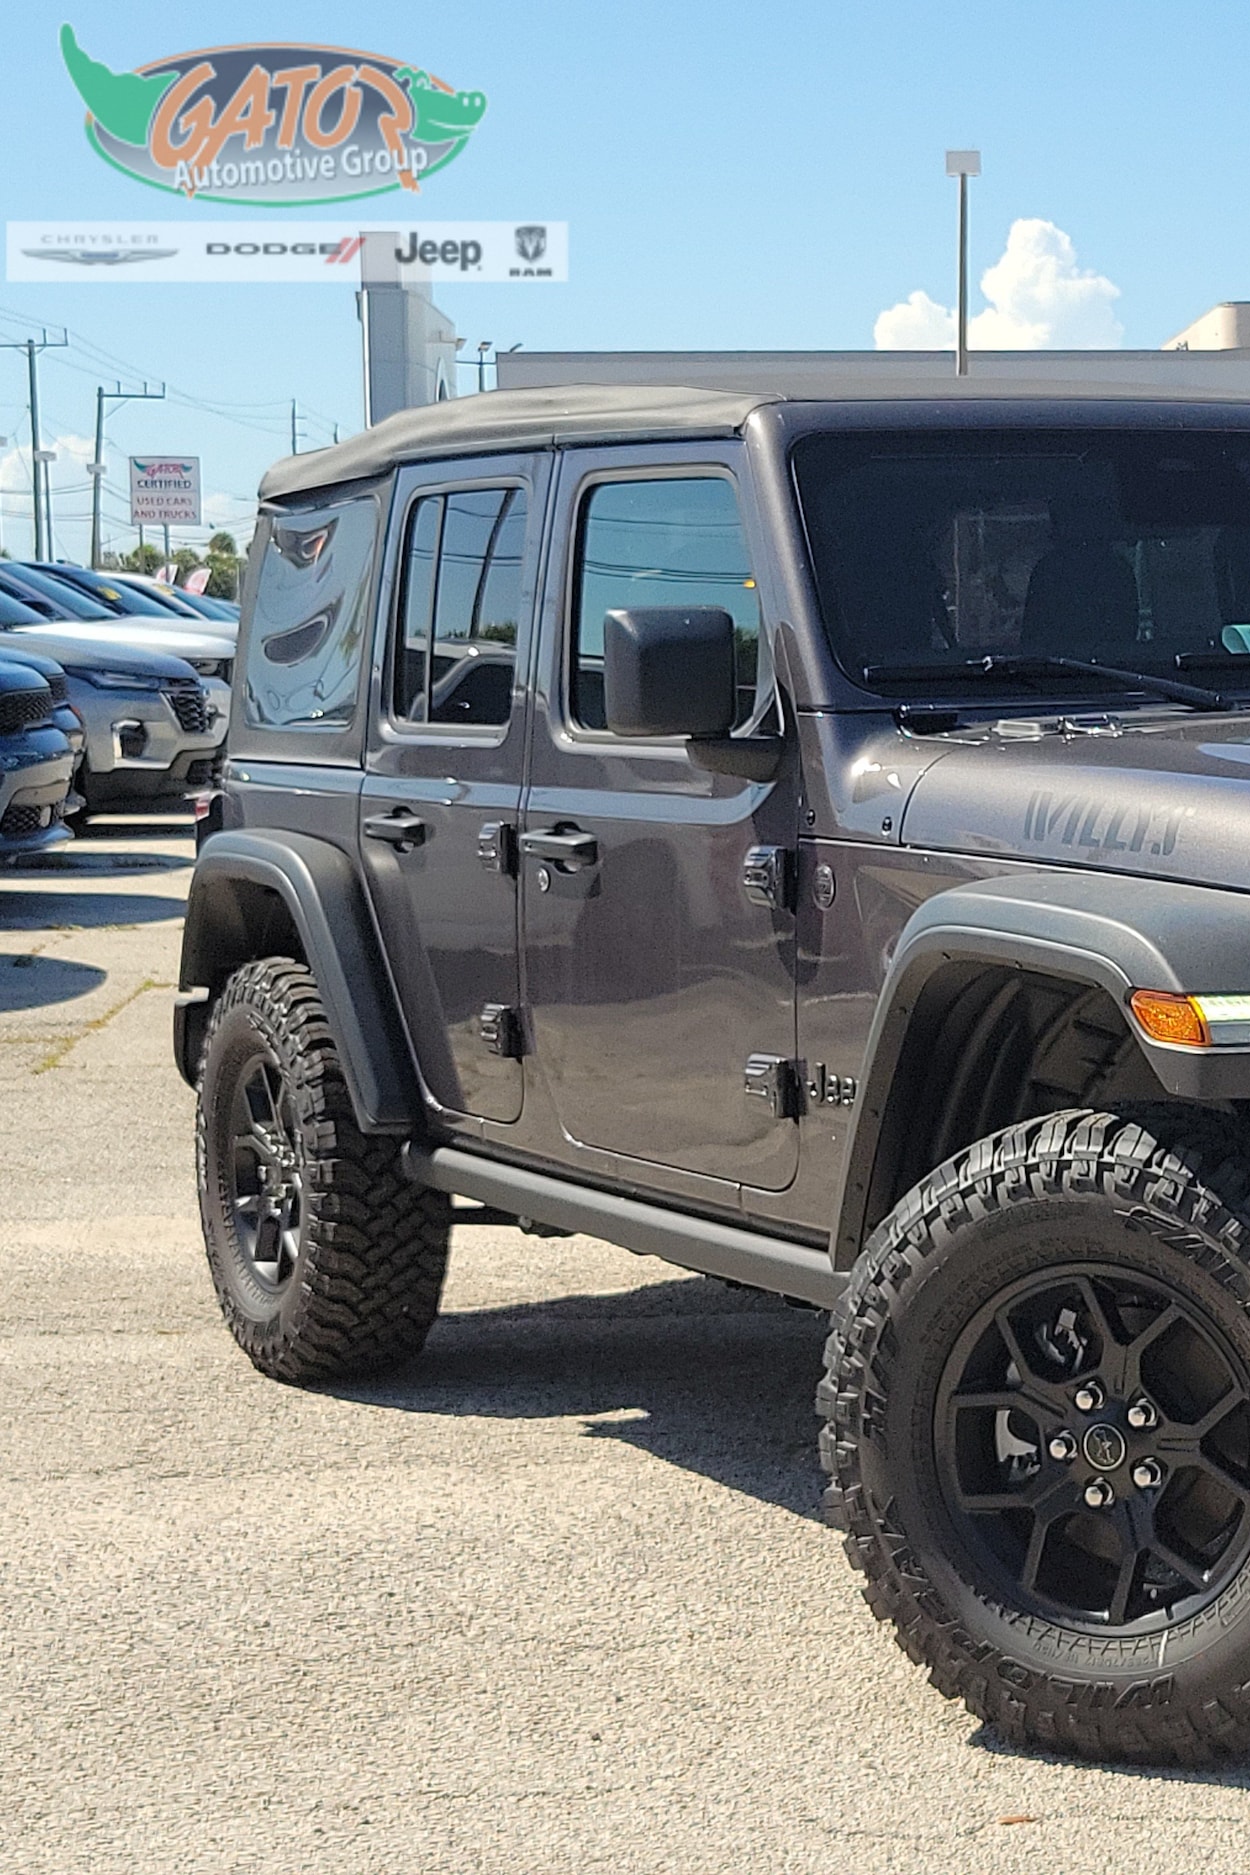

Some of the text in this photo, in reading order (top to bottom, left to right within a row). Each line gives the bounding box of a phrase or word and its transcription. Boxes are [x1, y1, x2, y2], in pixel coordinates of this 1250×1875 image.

[137, 479, 193, 490] CERTIFIED
[137, 496, 193, 506] USED CARS
[133, 510, 197, 519] AND TRUCKS
[806, 1062, 859, 1107] Jee
[879, 1495, 1175, 1707] WILDPEAK
